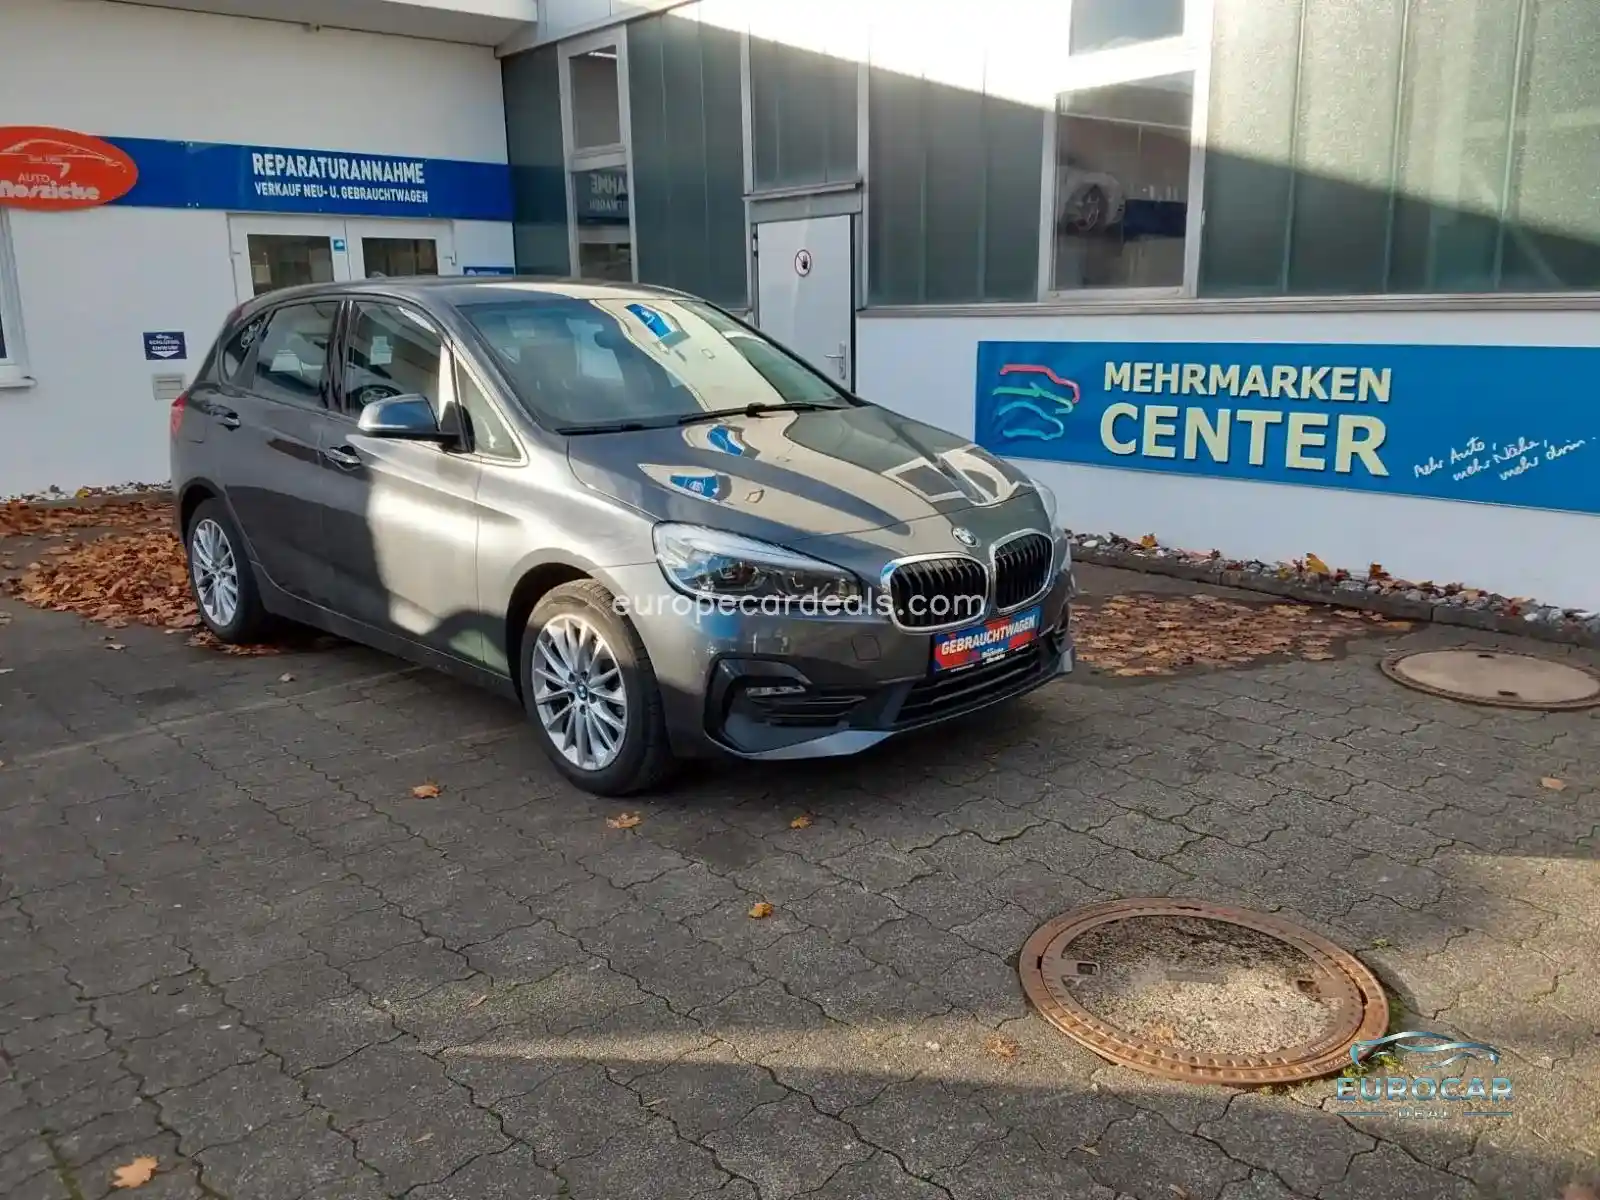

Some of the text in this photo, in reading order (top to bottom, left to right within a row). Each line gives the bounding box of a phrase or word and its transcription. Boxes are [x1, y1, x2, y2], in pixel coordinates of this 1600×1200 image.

[18, 172, 50, 183] AUTO
[252, 153, 425, 184] REPARATURANNAHME
[255, 182, 428, 203] VERKAUF NEU- U. GEBRAUCHTWAGEN
[1104, 361, 1393, 403] MEHRMARKEN
[1100, 402, 1390, 476] CENTER
[941, 615, 1036, 655] GEBRAUCHTWAGEN
